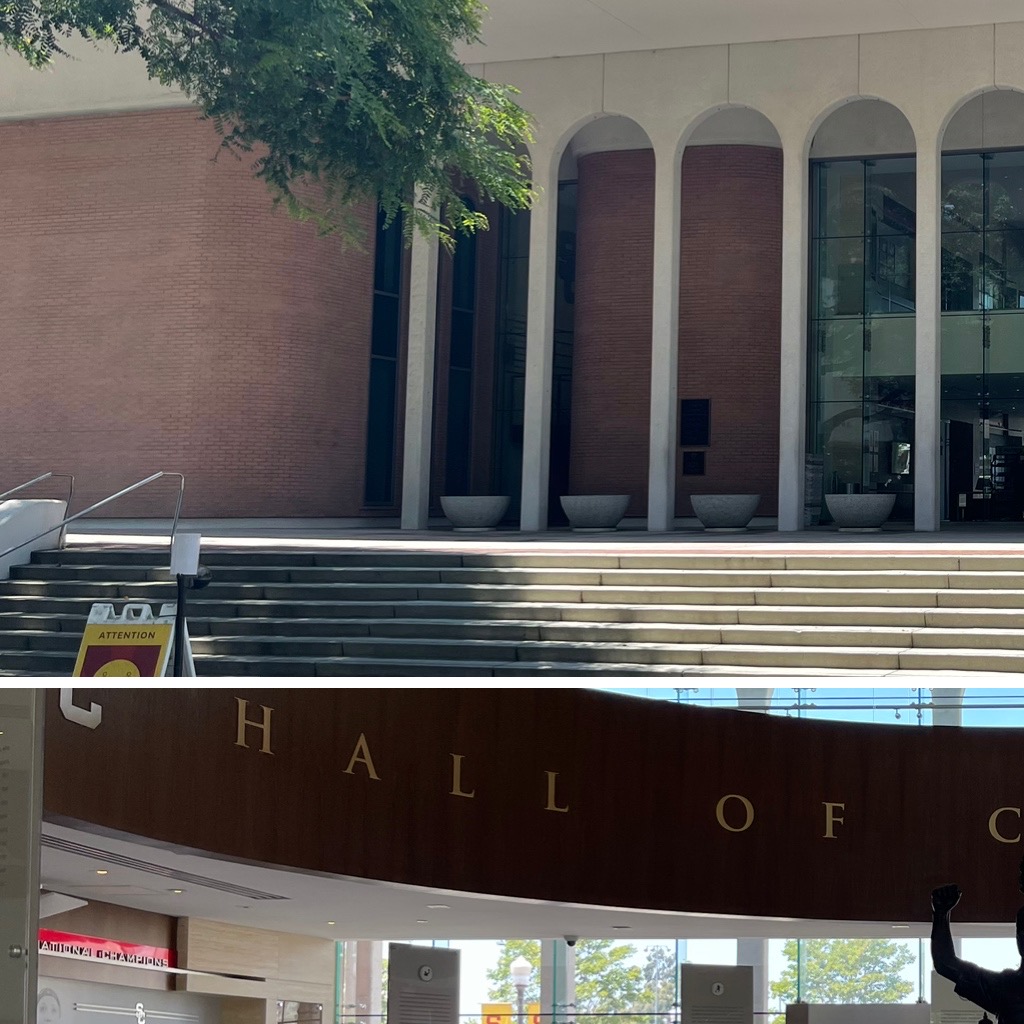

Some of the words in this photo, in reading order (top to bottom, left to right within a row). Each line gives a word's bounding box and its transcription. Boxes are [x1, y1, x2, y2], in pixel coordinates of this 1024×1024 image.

[98, 631, 156, 640] ATTENTION
[233, 696, 570, 813] HALL
[714, 793, 846, 839] OF
[98, 950, 169, 968] CHAMPIONS
